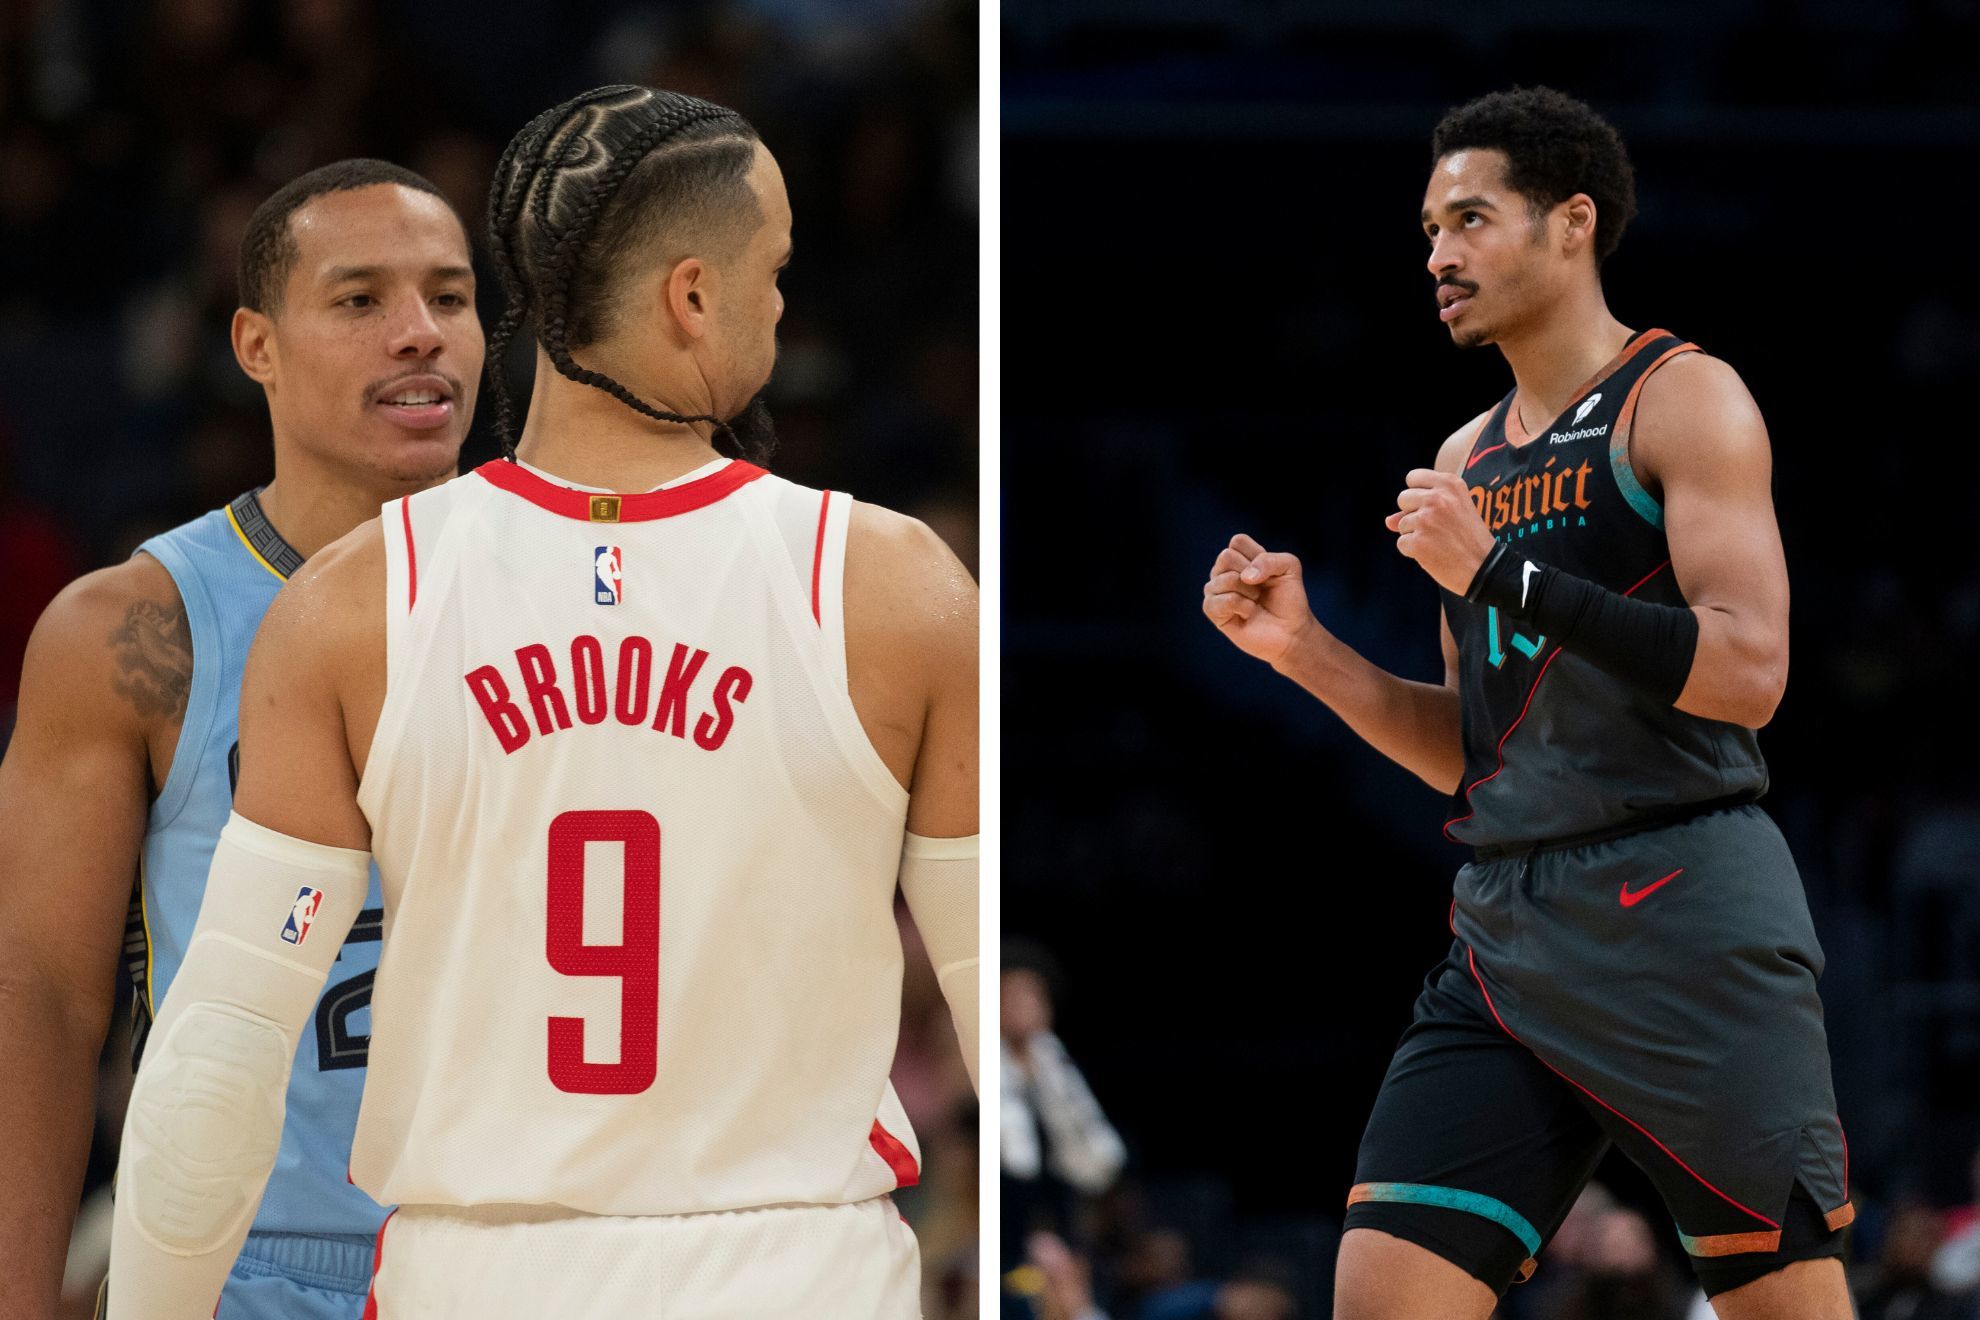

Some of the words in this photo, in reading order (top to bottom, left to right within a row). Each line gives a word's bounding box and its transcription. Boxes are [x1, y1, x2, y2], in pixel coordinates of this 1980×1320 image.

[1549, 424, 1608, 445] Robinhood
[464, 634, 753, 755] BROOKS
[546, 809, 661, 1095] 9
